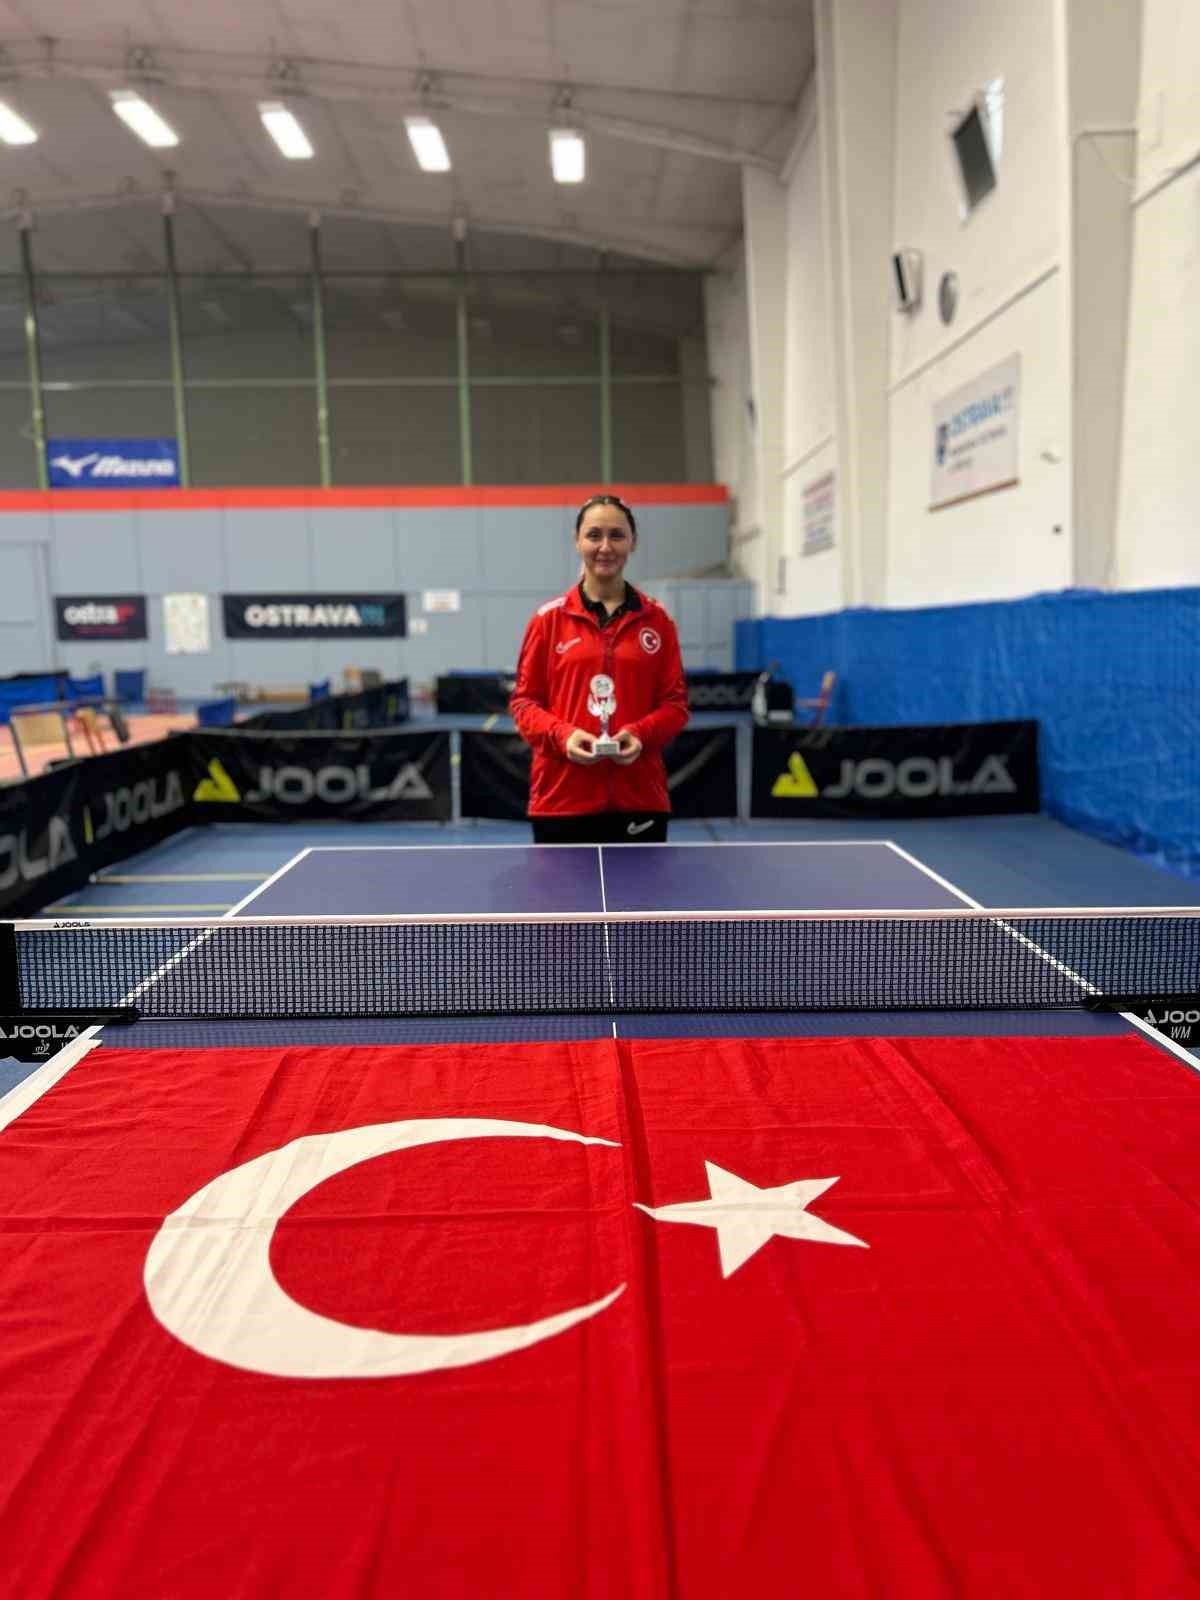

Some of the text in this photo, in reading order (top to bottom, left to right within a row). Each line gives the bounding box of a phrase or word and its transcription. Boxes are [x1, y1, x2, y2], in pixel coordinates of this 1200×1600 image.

[245, 763, 435, 803] JOOLA
[822, 754, 1017, 798] JOOLA
[96, 770, 184, 840] JOOLA
[9, 1024, 80, 1038] JOOLA
[1171, 1026, 1191, 1039] WM
